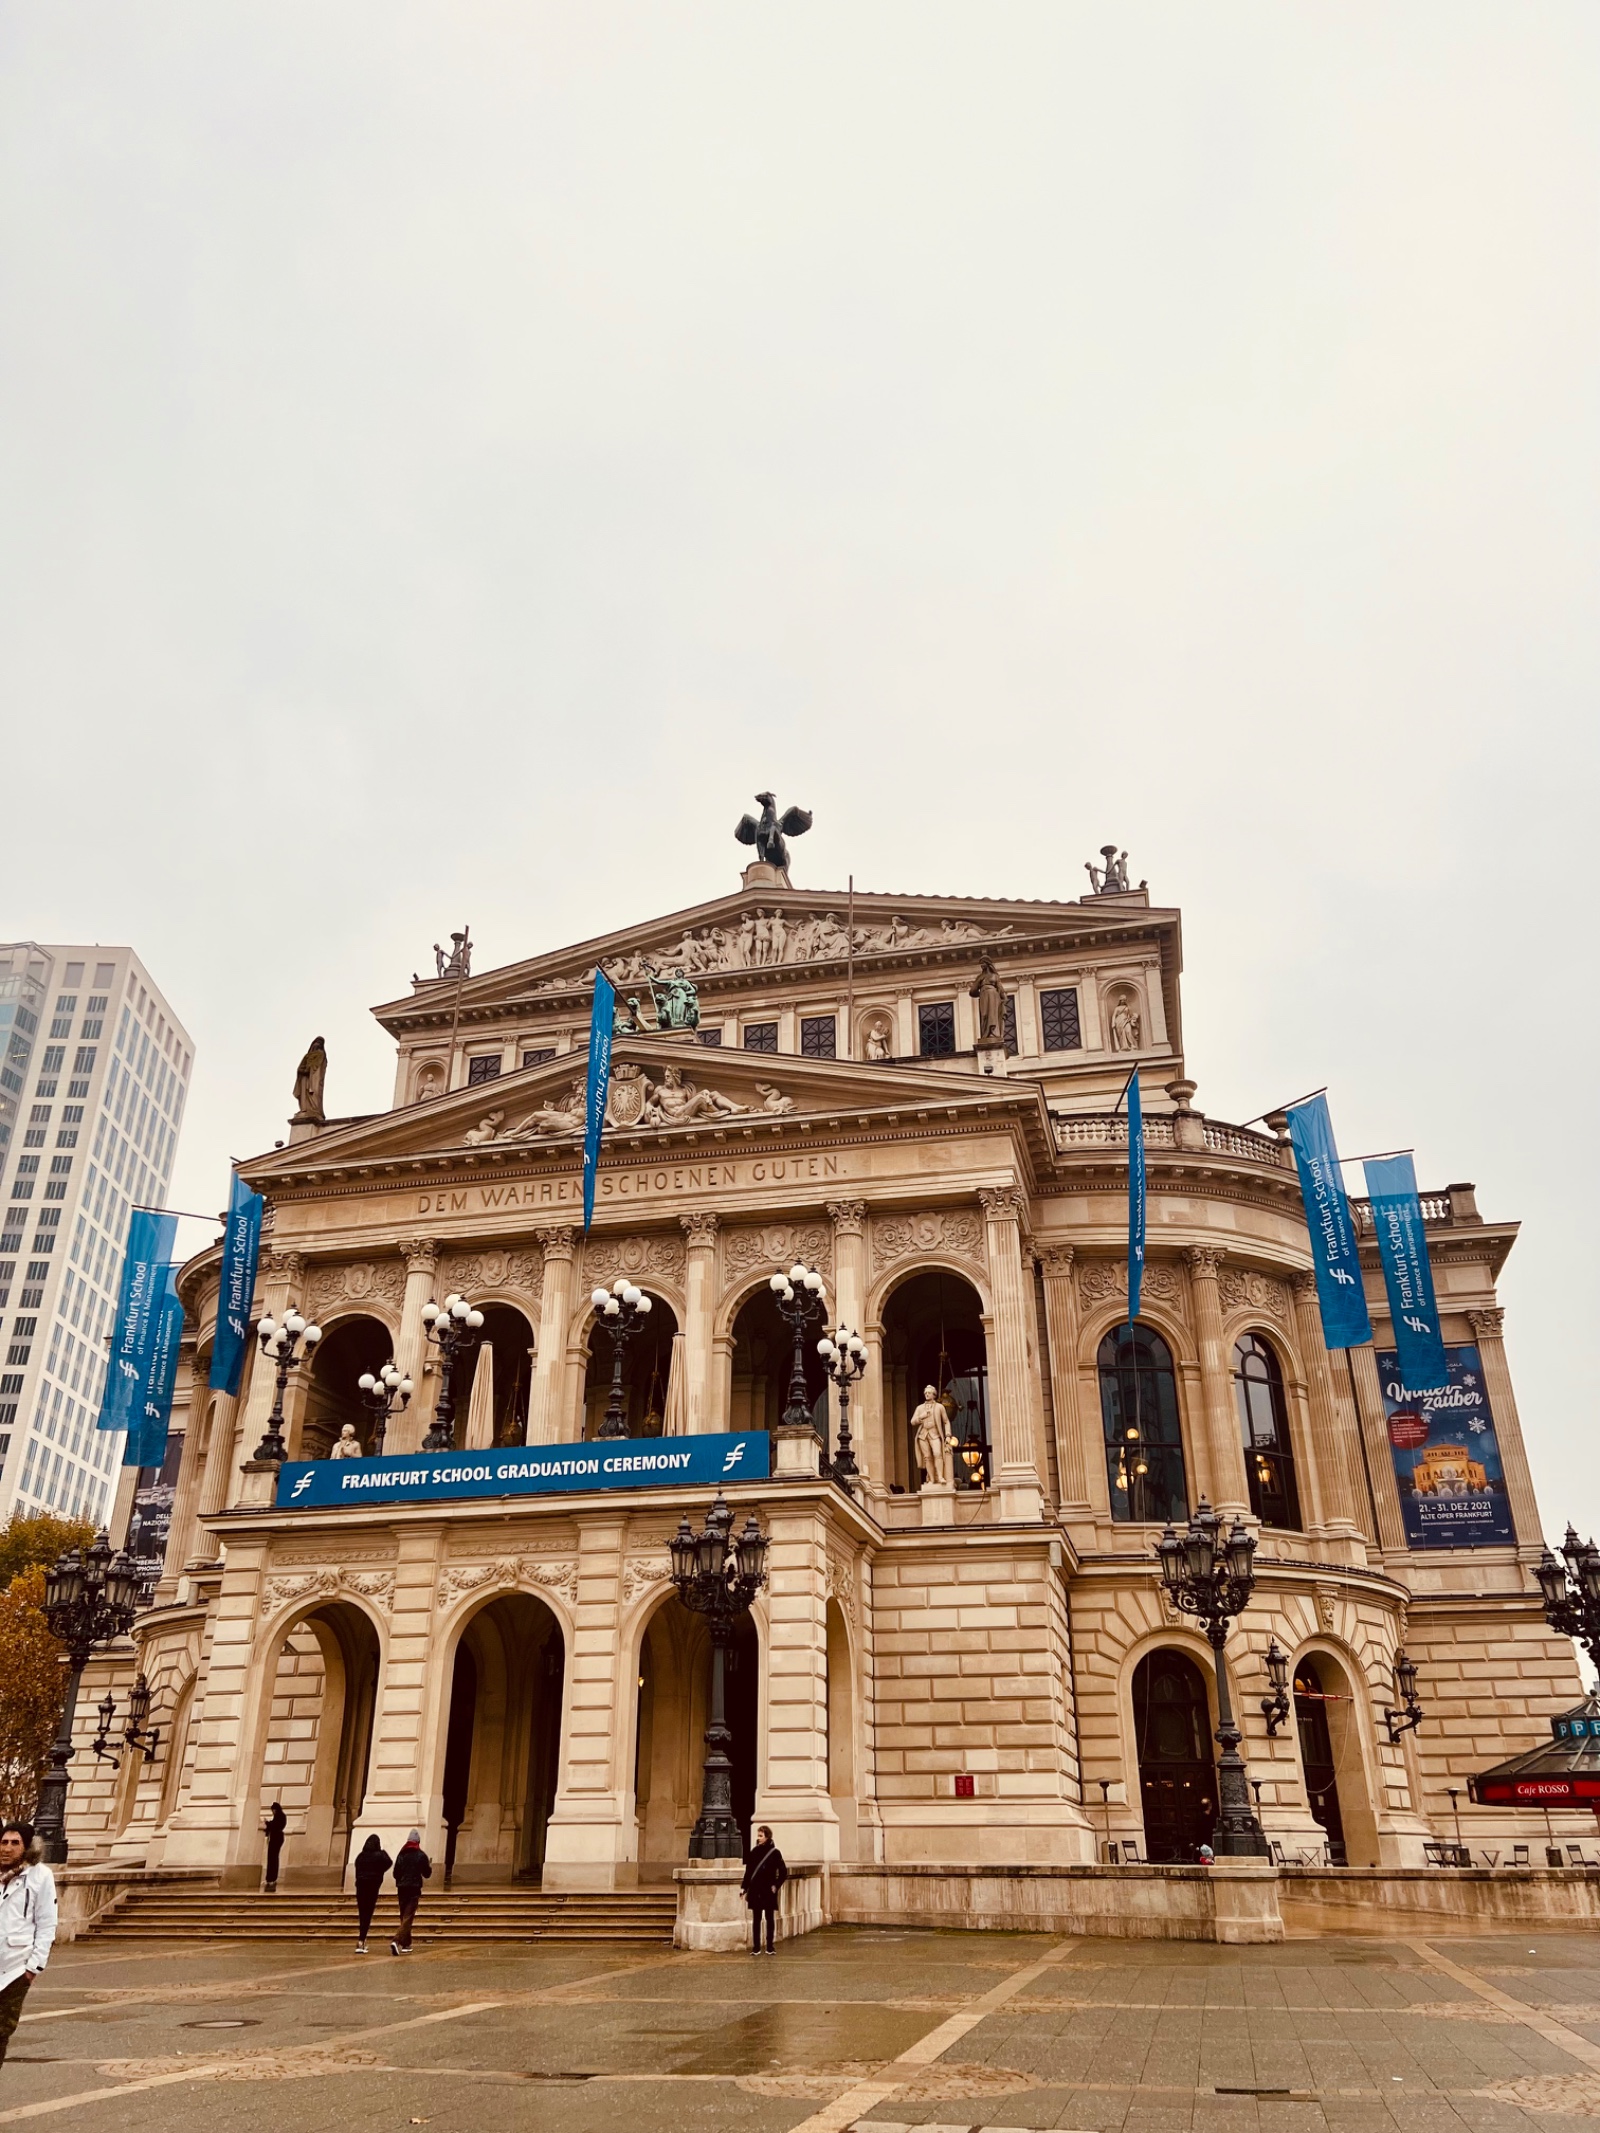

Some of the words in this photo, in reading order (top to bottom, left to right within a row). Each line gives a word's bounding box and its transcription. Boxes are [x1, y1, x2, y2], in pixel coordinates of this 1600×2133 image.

[417, 1191, 468, 1214] DEM
[480, 1181, 585, 1209] WAHREN
[601, 1164, 738, 1196] SCHOENEN
[752, 1155, 848, 1181] GUTEN.
[1308, 1157, 1327, 1201] School
[1323, 1153, 1340, 1206] Management
[1334, 1206, 1341, 1214] &
[233, 1215, 248, 1255] School
[1320, 1202, 1340, 1262] Frankfurt
[1337, 1215, 1348, 1245] Finance
[1384, 1210, 1404, 1252] School
[1405, 1209, 1418, 1259] Management
[1344, 1245, 1350, 1256] of
[129, 1261, 147, 1299] School
[146, 1264, 158, 1310] Management
[228, 1257, 245, 1311] Frankfurt
[1394, 1253, 1415, 1309] Frankfurt
[1415, 1268, 1425, 1296] Finance
[1420, 1296, 1426, 1306] of
[120, 1302, 140, 1354] Frankfurt
[138, 1318, 149, 1343] Finance
[163, 1310, 174, 1353] Management
[137, 1345, 144, 1355] of
[158, 1360, 167, 1384] Finance
[157, 1385, 163, 1395] of
[1423, 1389, 1483, 1411] zauber
[341, 1469, 428, 1490] FRANKFURT
[432, 1465, 493, 1484] SCHOOL
[496, 1459, 599, 1480] GRADUATION
[603, 1453, 692, 1473] CEREMONY
[1450, 1502, 1469, 1511] DEZ
[1471, 1501, 1491, 1510] 2021
[1561, 1725, 1567, 1736] P
[1574, 1723, 1584, 1736] P
[1517, 1785, 1536, 1796] Cafe
[1538, 1784, 1569, 1794] ROSSO
